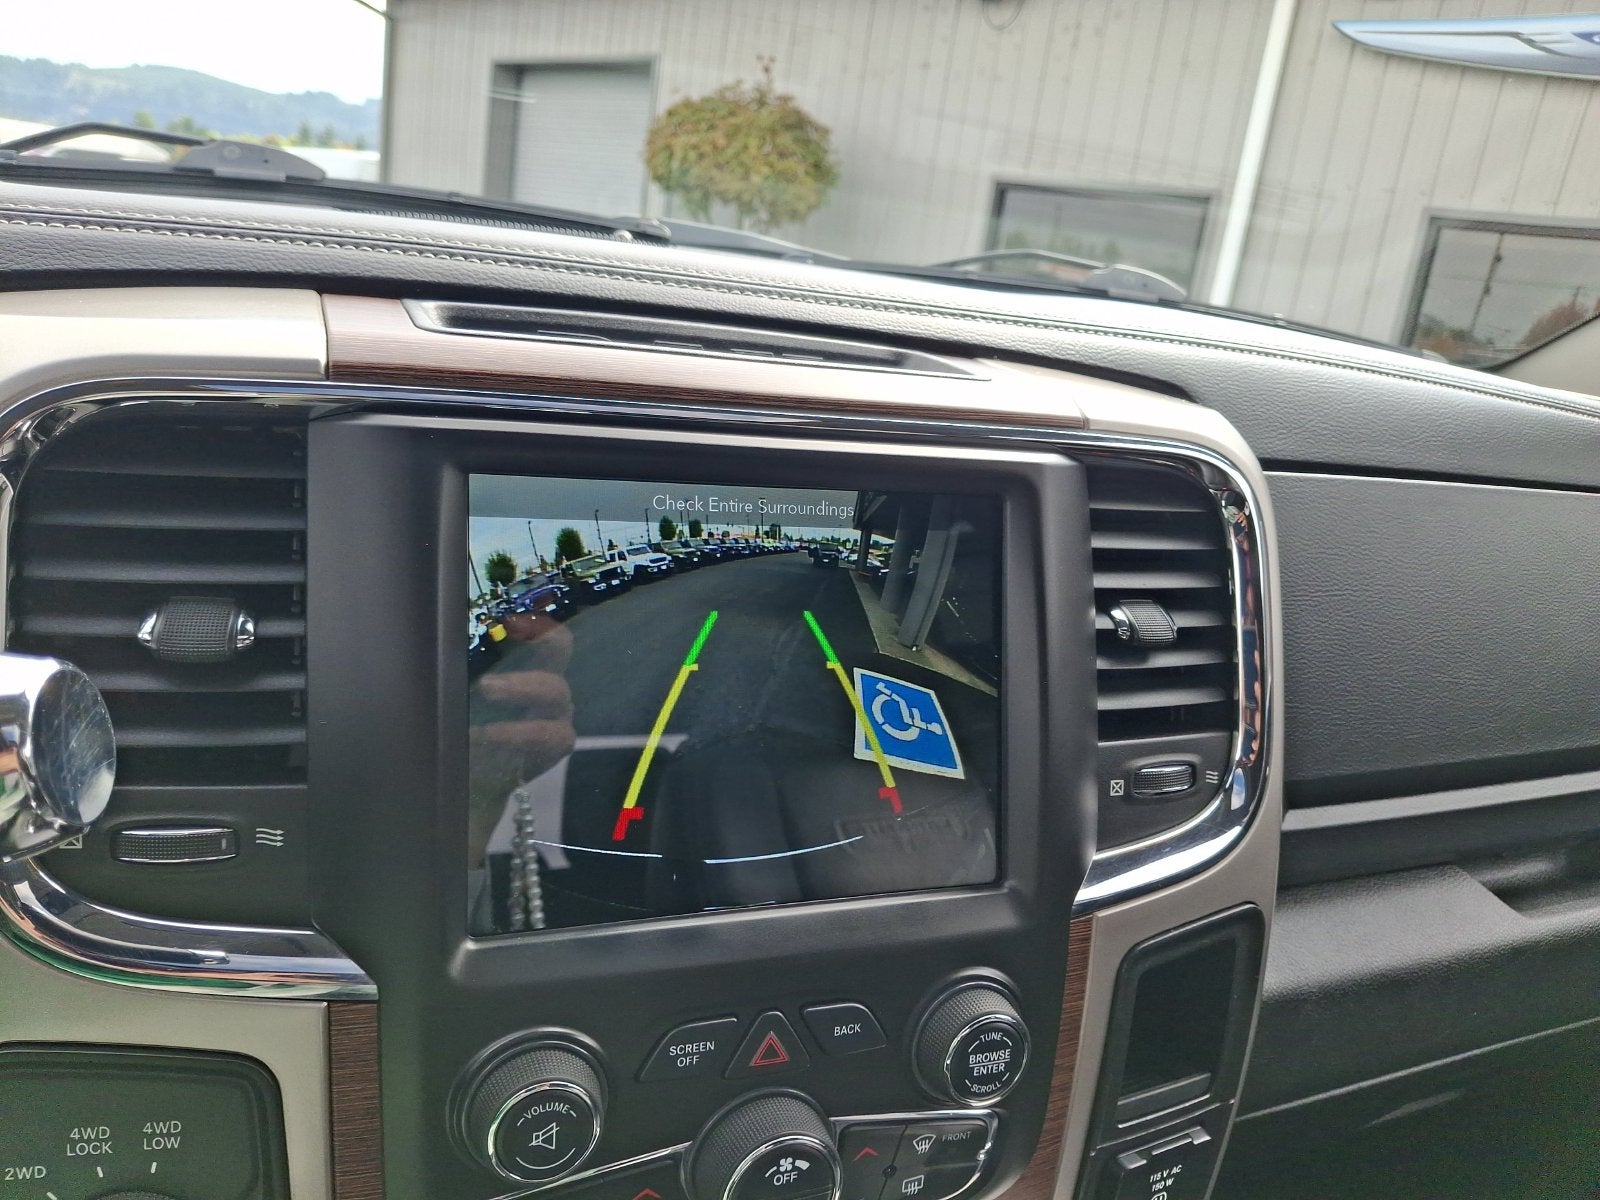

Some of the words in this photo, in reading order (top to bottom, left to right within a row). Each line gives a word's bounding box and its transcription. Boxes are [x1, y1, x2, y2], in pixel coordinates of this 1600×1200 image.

[653, 494, 704, 512] Check
[708, 497, 753, 513] Entire
[758, 499, 854, 519] Surroundings
[834, 1023, 861, 1036] BACK
[980, 1031, 1003, 1043] TUNE
[669, 1041, 715, 1056] SCREEN
[677, 1055, 700, 1067] OFF
[969, 1048, 1011, 1065] BROWSE
[973, 1063, 1005, 1076] ENTER
[970, 1081, 1002, 1093] SCROLL
[524, 1102, 570, 1120] VOLUME
[70, 1126, 110, 1141] 4WD
[142, 1120, 182, 1135] 4WD
[143, 1136, 181, 1150] LOW
[942, 1131, 971, 1142] FRONT
[66, 1141, 113, 1156] LOCK
[4, 1166, 47, 1181] 2WD
[773, 1172, 798, 1186] OFF
[1150, 1171, 1162, 1183] 115
[1163, 1169, 1170, 1178] V
[1170, 1164, 1182, 1175] AC
[1152, 1180, 1165, 1192] 150
[1166, 1177, 1174, 1187] W
